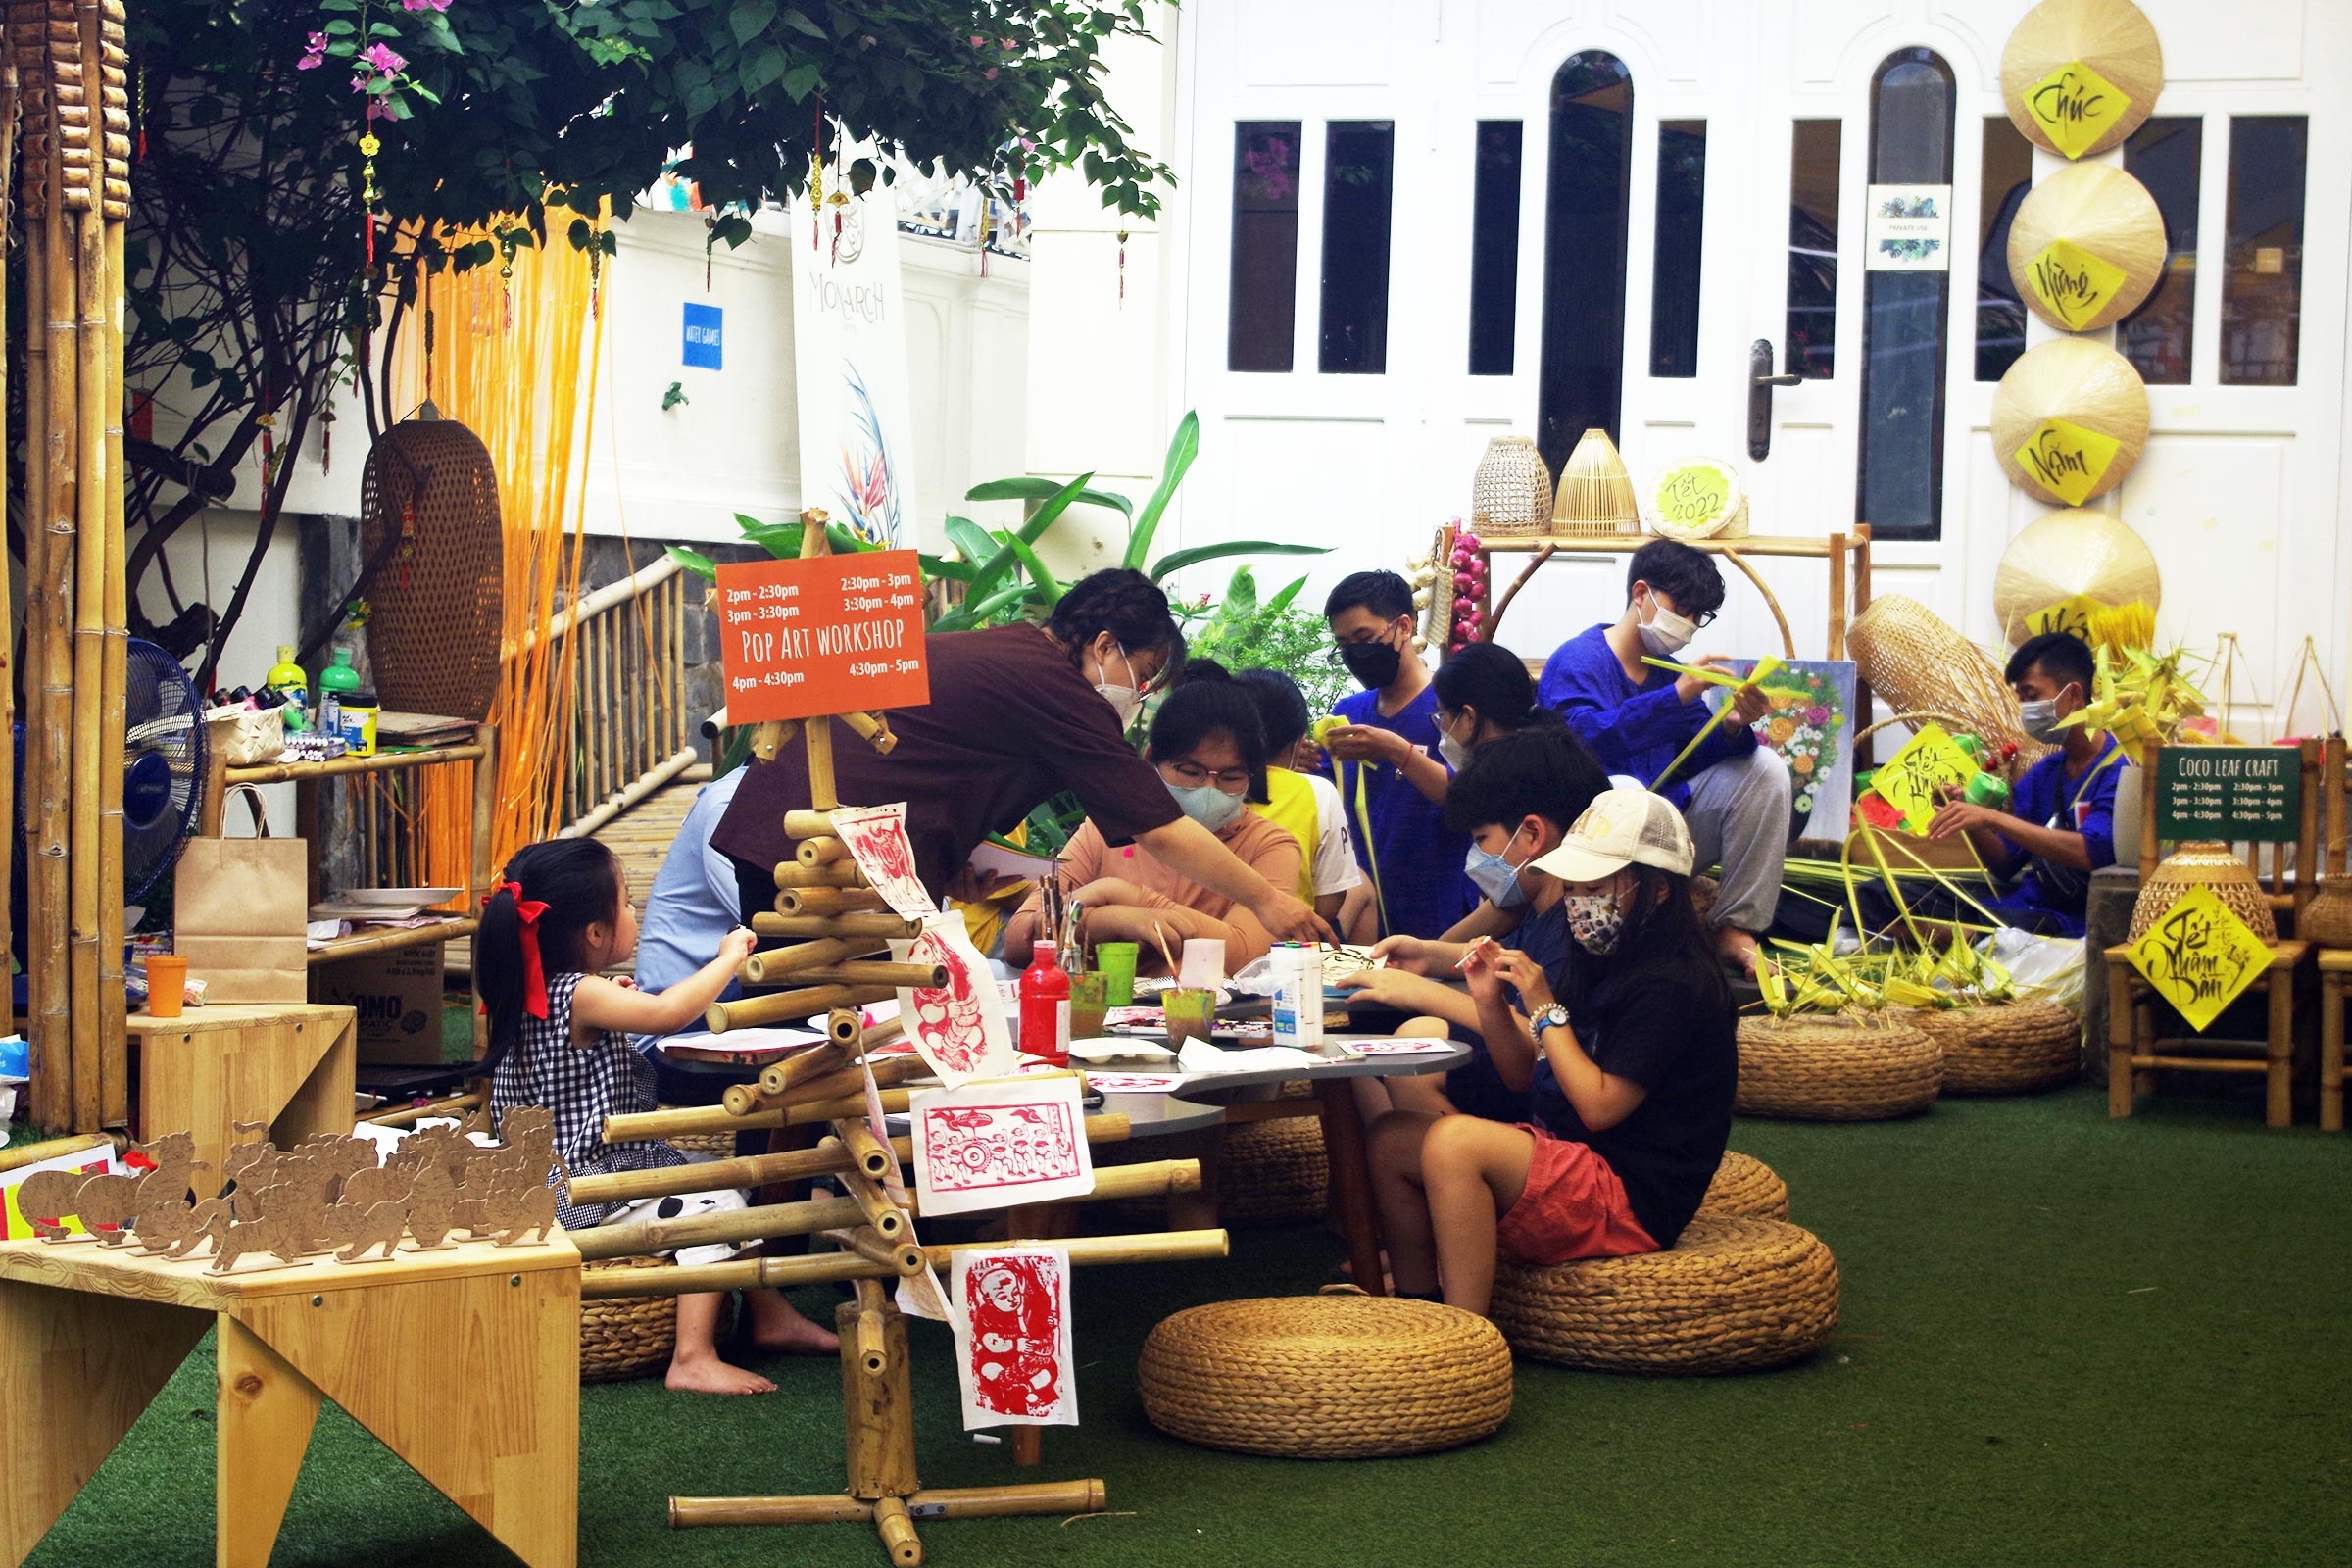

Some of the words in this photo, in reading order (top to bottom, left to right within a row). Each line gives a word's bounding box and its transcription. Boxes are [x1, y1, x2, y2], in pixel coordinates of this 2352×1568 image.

[809, 271, 885, 324] MONARCH
[1672, 492, 1719, 520] 2022
[840, 576, 880, 593] 2:30pm
[887, 573, 912, 590] 3pm
[726, 588, 752, 606] 2pm
[759, 584, 800, 601] 2:30pm
[843, 596, 883, 612] 3:30pm
[890, 593, 914, 610] 4pm
[727, 609, 752, 626] 3pm
[759, 605, 800, 621] 3:30pm
[849, 662, 888, 678] 4:30pm
[895, 658, 919, 675] 5pm
[732, 676, 757, 693] 4pm
[763, 670, 805, 688] 4:30pm
[2171, 782, 2188, 792] 2pm
[2193, 782, 2222, 792] 2:30pm
[2233, 782, 2262, 792] 2:30pm
[2267, 782, 2284, 792] 3pm
[2172, 797, 2188, 806] 3pm
[2193, 797, 2222, 806] 3:30pm
[2232, 797, 2261, 807] 3:30pm
[2266, 797, 2283, 807] 4pm
[2171, 811, 2188, 820] 4pm
[2193, 811, 2222, 821] 4:30pm
[2231, 811, 2260, 821] 4:30pm
[2265, 811, 2283, 821] 5pm
[354, 994, 402, 1020] OMO
